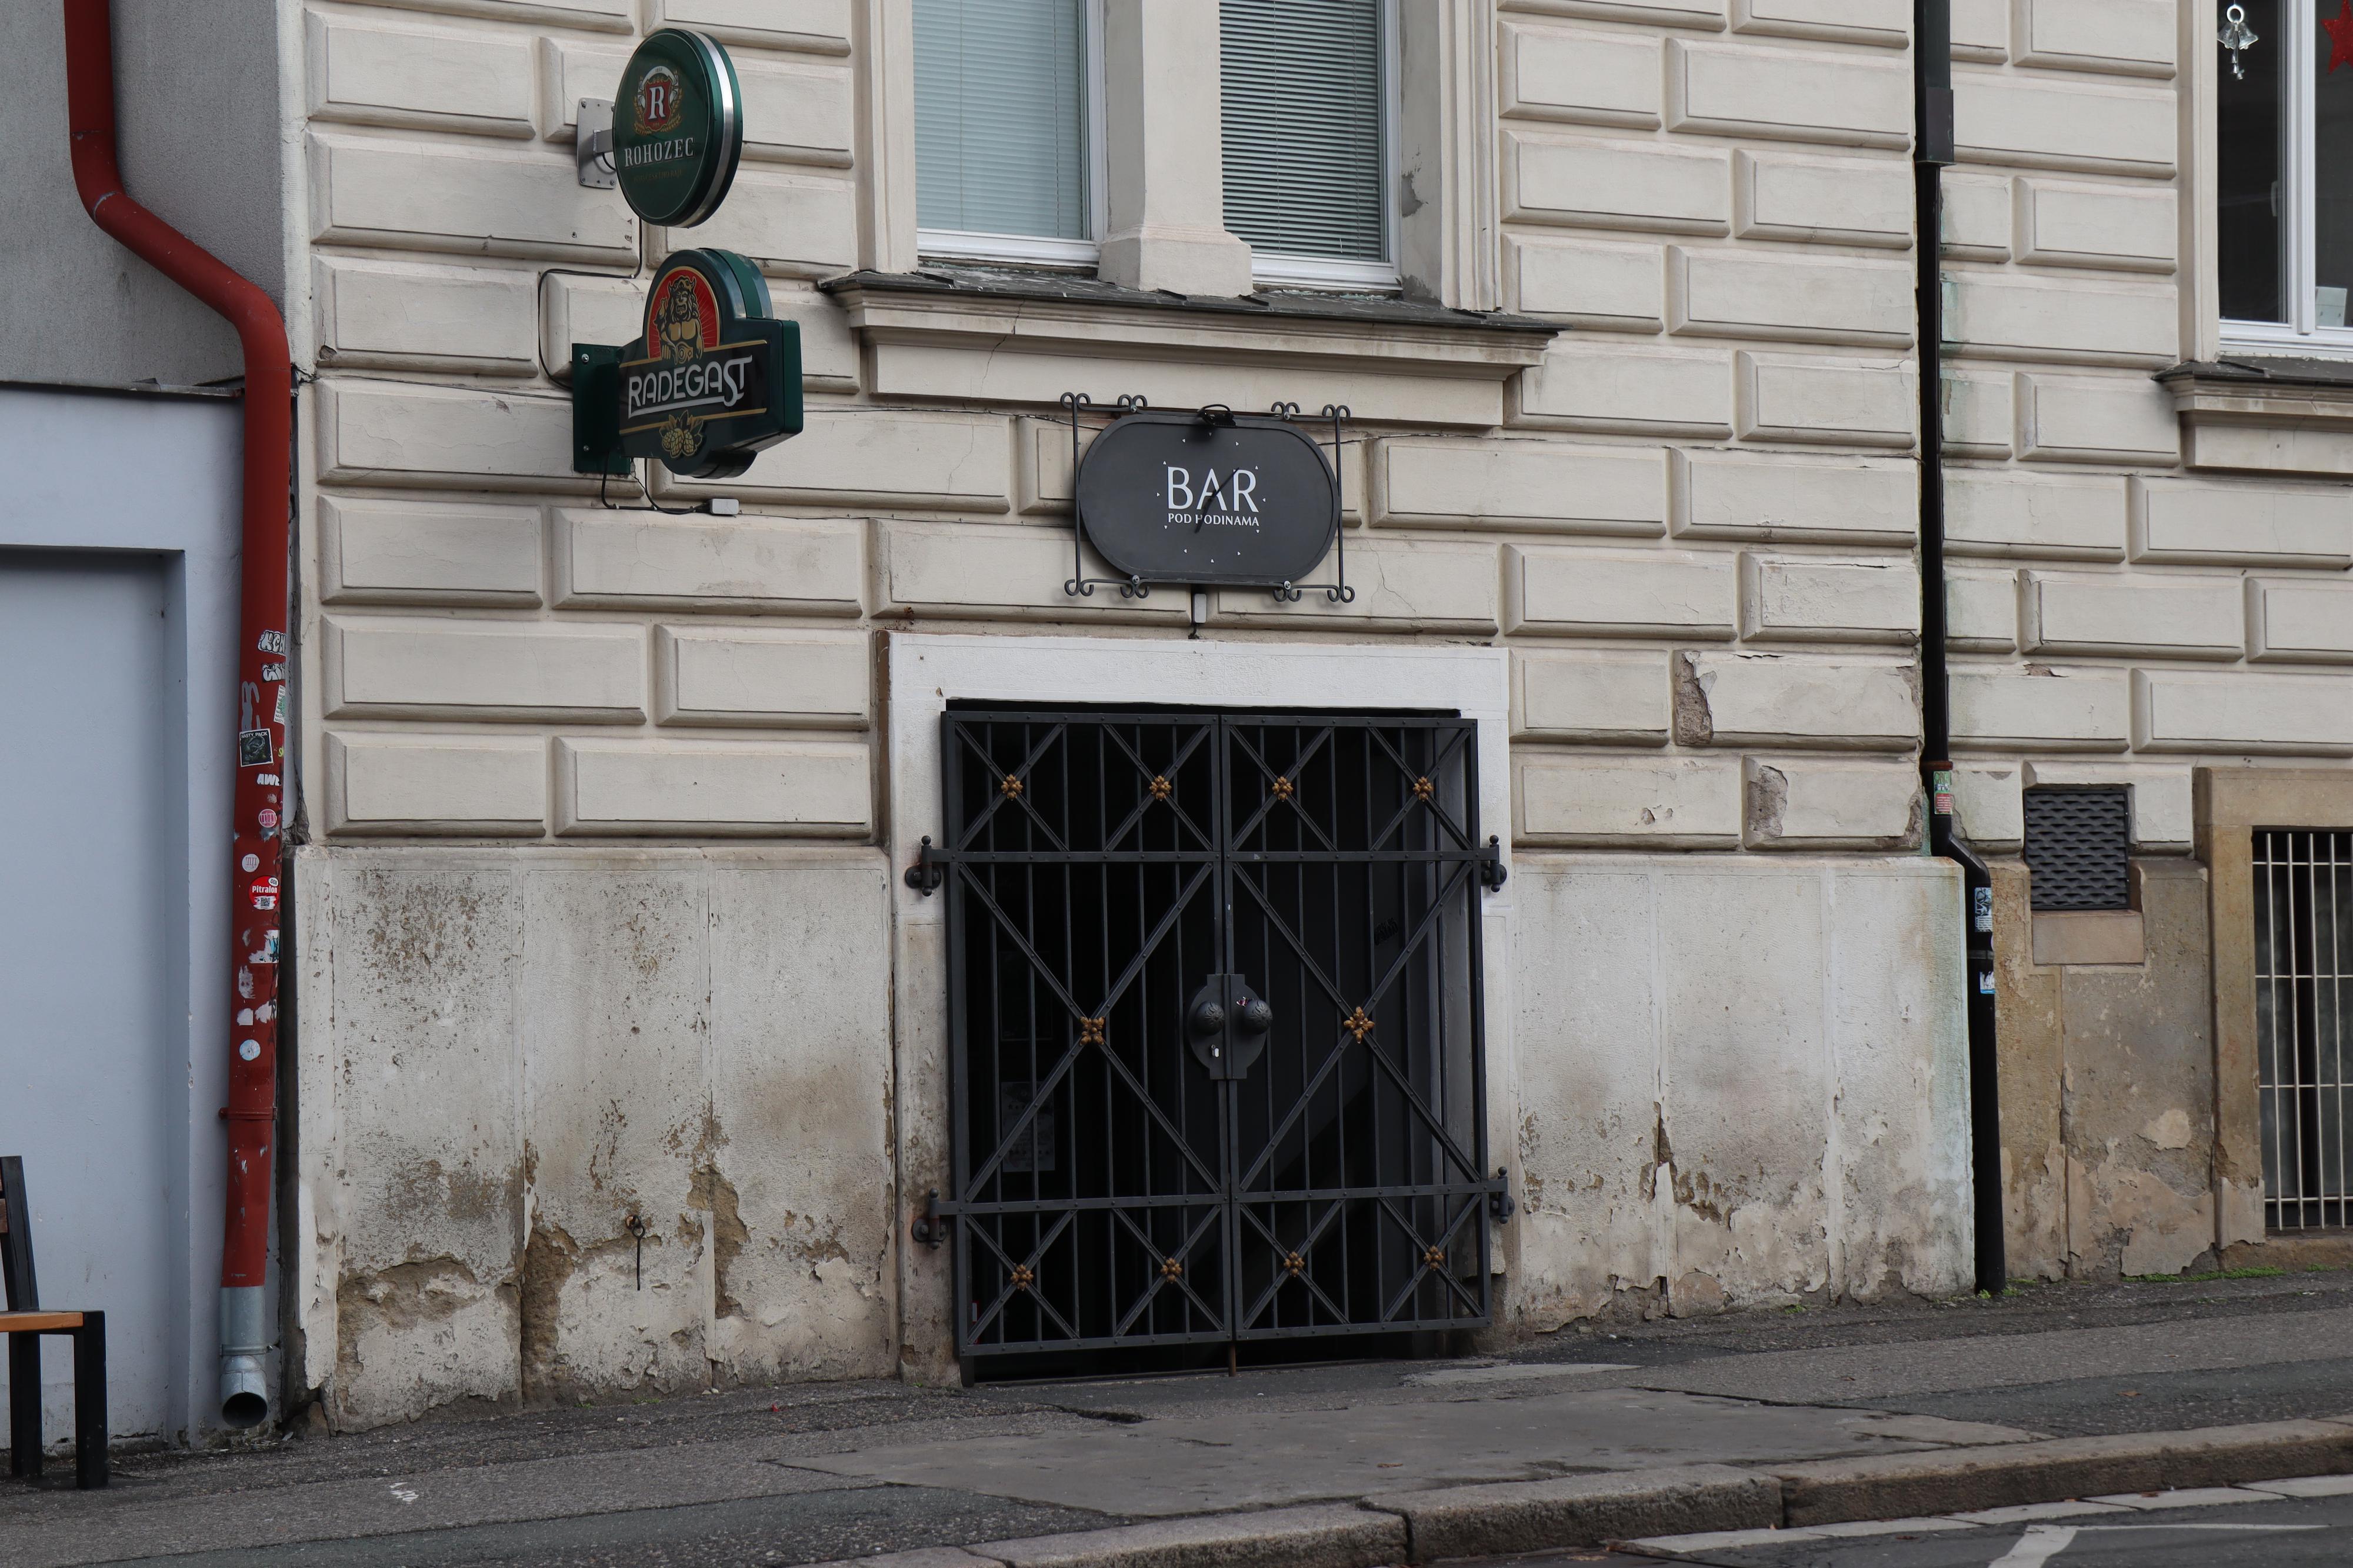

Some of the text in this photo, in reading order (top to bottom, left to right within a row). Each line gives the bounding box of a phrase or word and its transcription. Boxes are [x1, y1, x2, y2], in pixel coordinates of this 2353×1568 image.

[648, 86, 666, 120] R
[624, 137, 695, 168] ROHOZEC
[628, 355, 752, 419] RADEGAST
[1168, 466, 1259, 513] BAR
[1168, 513, 1259, 526] POD HODINAMA
[252, 885, 278, 893] Pitralon
